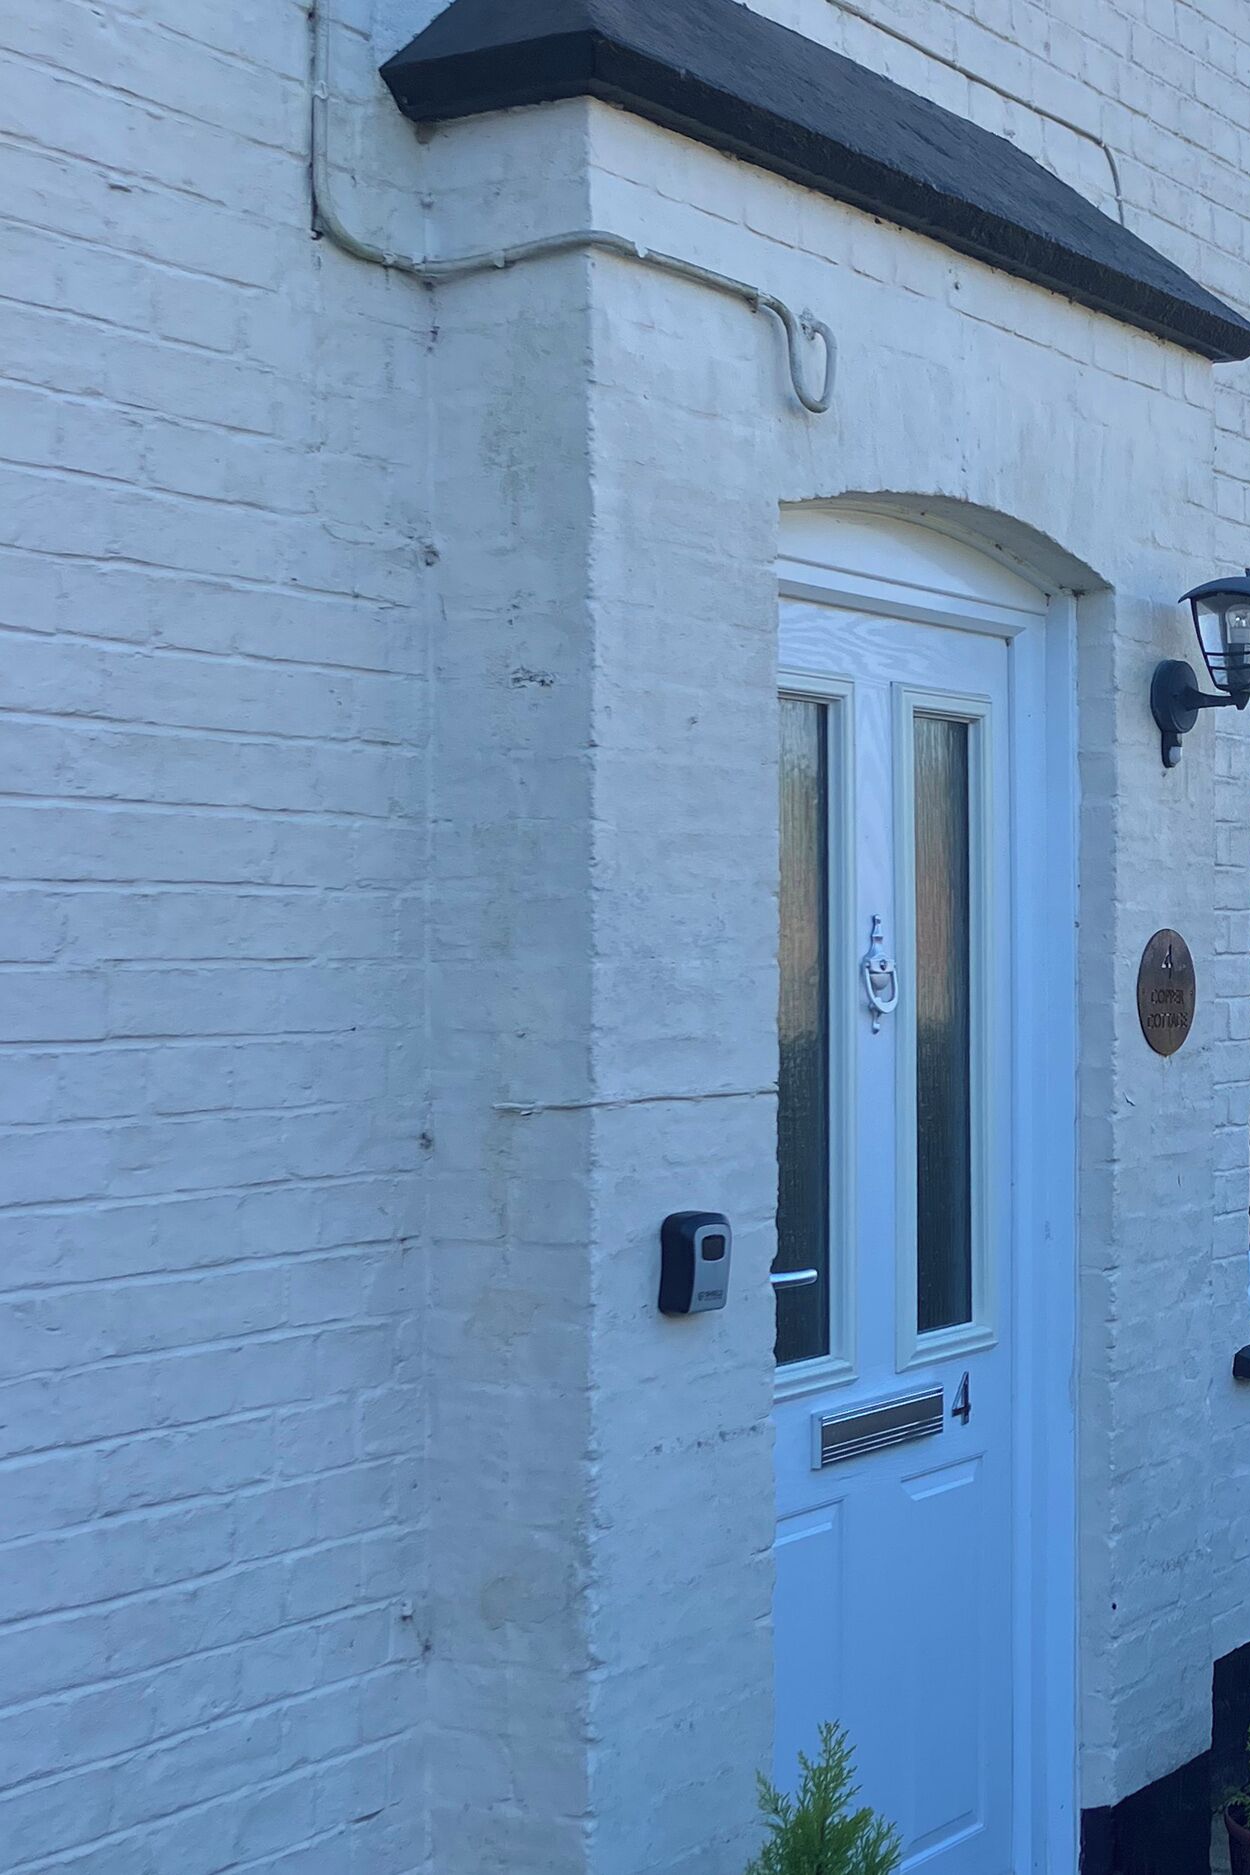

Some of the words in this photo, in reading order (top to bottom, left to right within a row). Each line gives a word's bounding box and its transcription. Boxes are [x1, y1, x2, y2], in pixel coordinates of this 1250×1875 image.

[1161, 943, 1174, 980] 4
[1150, 988, 1185, 1005] COPPER
[951, 1371, 971, 1426] 4
